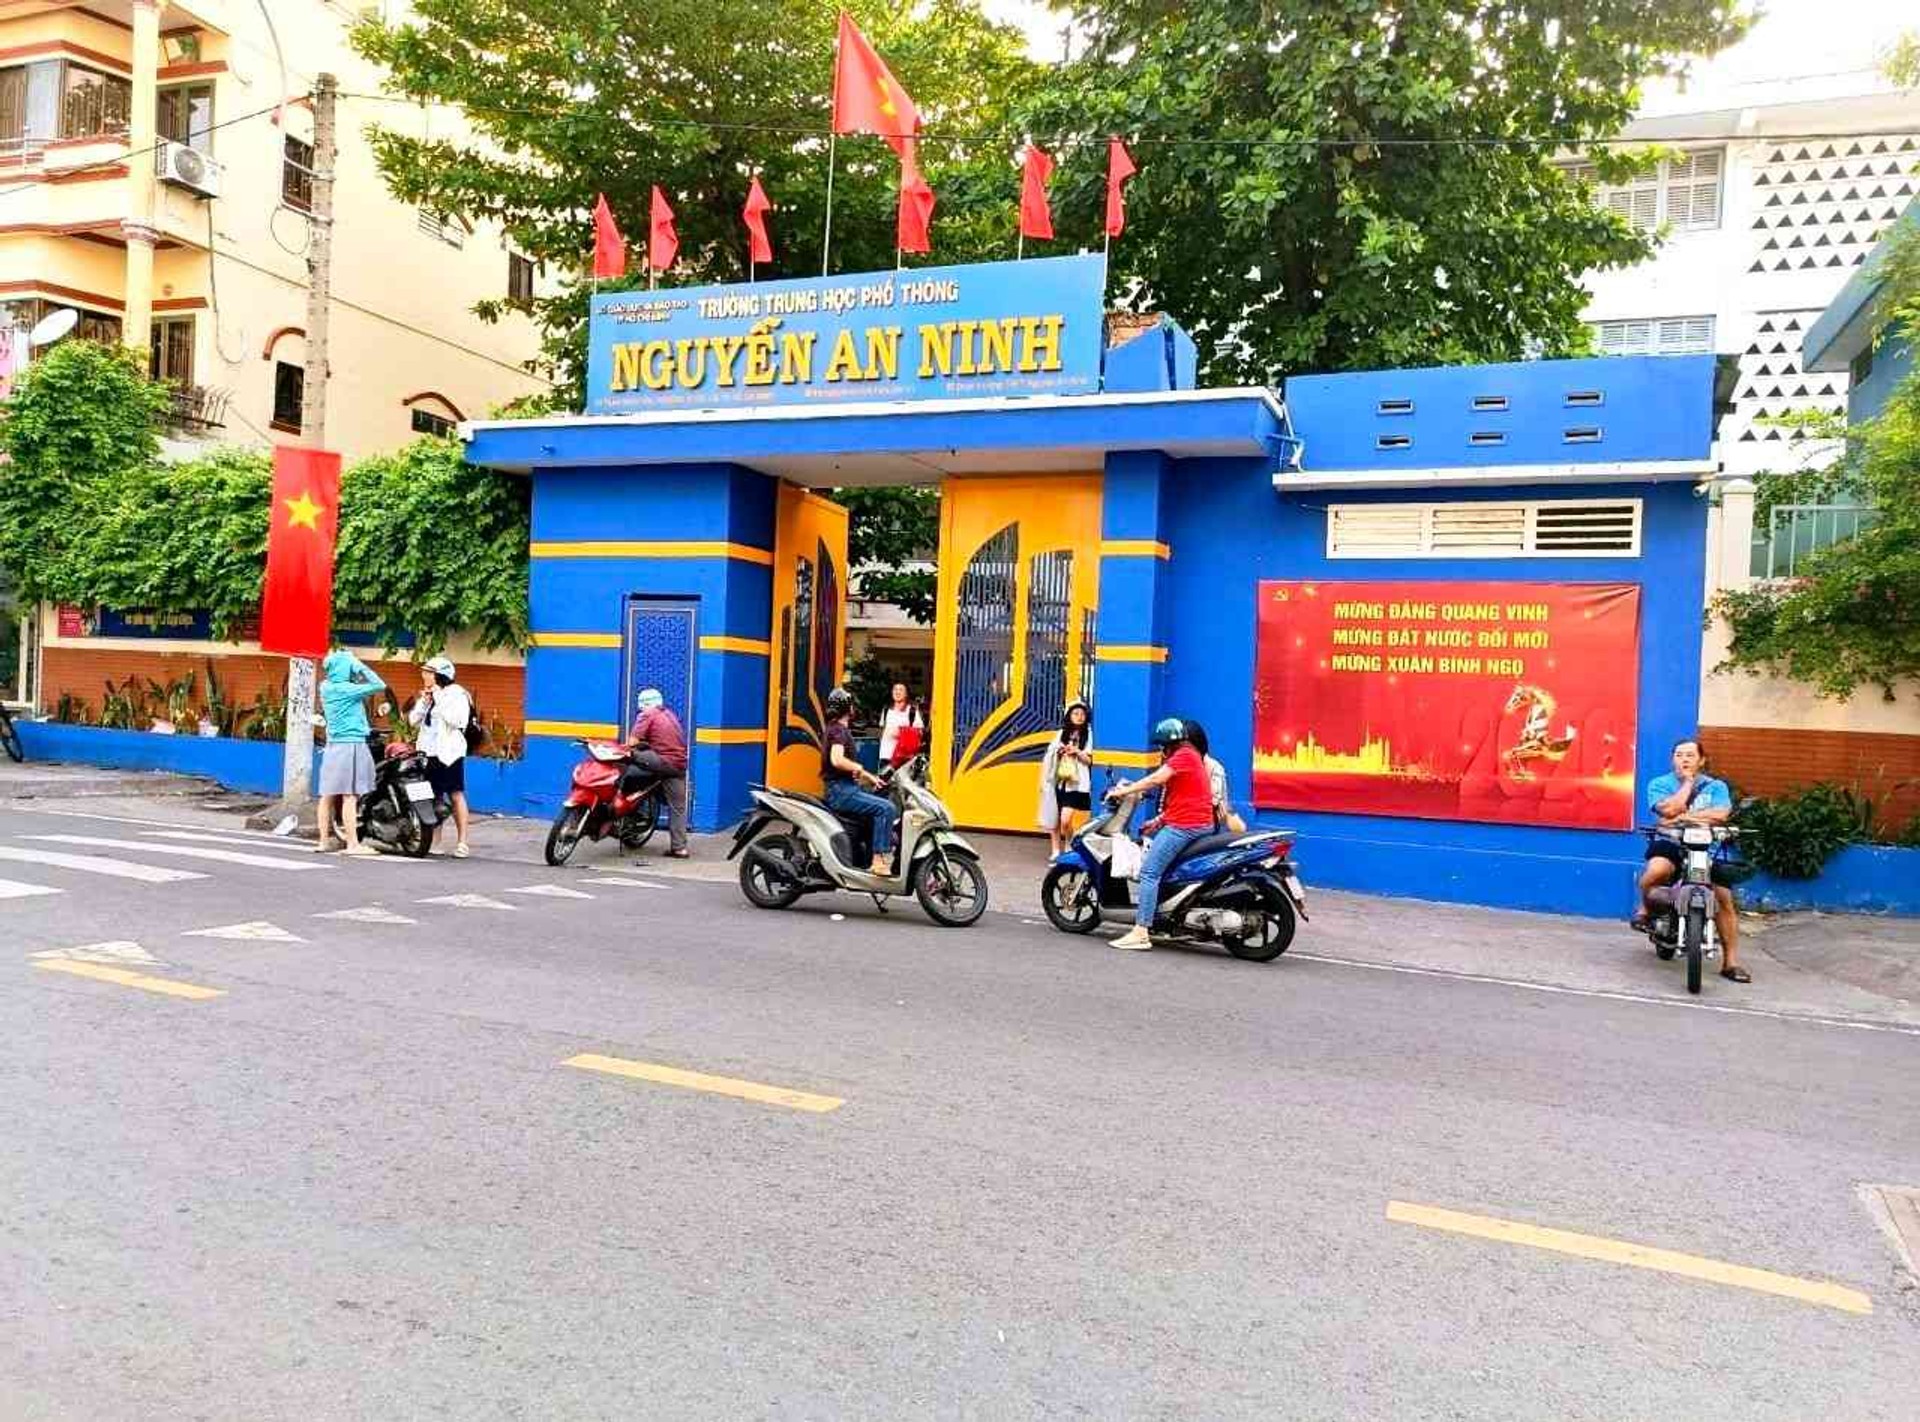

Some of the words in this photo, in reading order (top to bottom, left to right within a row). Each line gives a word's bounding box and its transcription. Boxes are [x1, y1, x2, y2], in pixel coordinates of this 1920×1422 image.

[699, 291, 761, 319] TRƯỜNG
[764, 291, 818, 314] TRUNG
[823, 287, 856, 315] HỌC
[862, 278, 896, 307] PHỔ
[901, 281, 960, 304] THÔNG
[610, 315, 817, 392] NGUYỄN
[825, 325, 902, 382] AN
[918, 313, 1064, 378] NINH
[1334, 601, 1384, 620] MỪNG
[1389, 600, 1438, 620] ĐẢNG
[1441, 603, 1501, 621] QUANG
[1506, 603, 1549, 621] VINH
[1333, 627, 1383, 645] MỪNG
[1424, 628, 1473, 647] NƯỚC
[1513, 629, 1549, 648] MỚI
[1332, 652, 1382, 672] MỪNG
[1387, 654, 1434, 673] XUÂN
[1486, 658, 1525, 678] NGỌ
